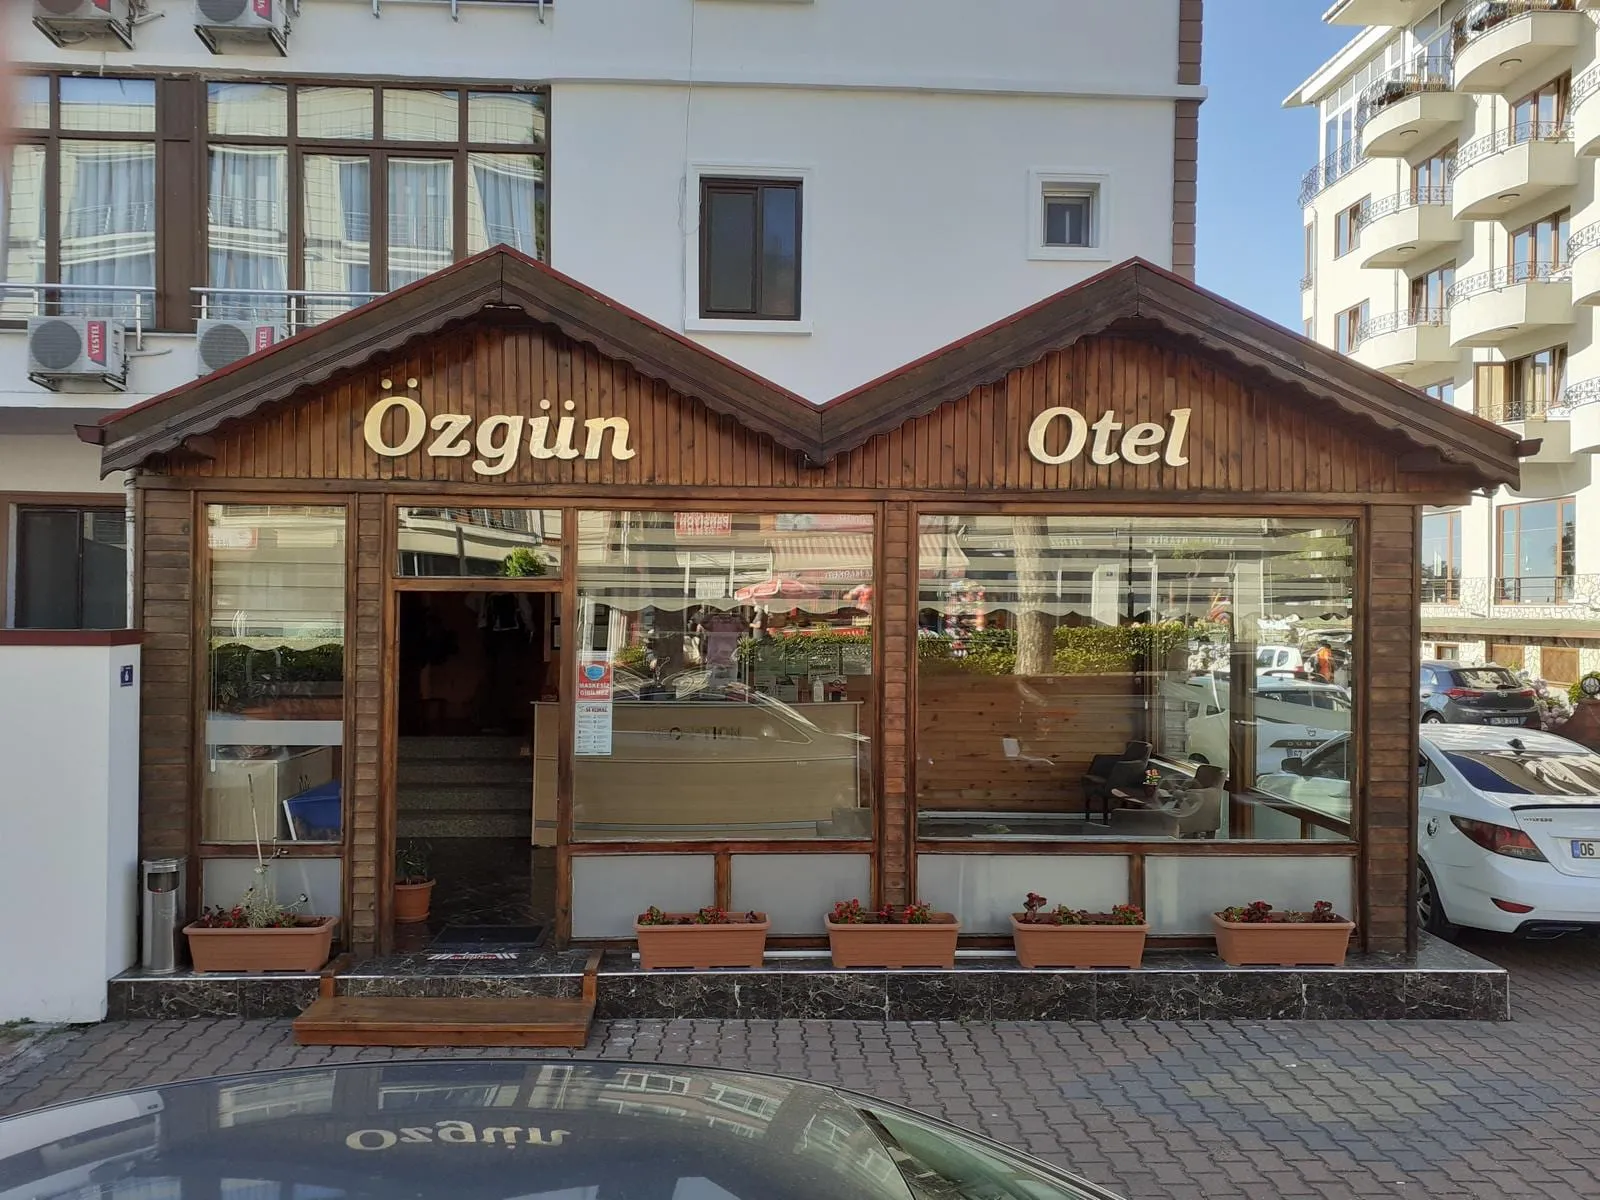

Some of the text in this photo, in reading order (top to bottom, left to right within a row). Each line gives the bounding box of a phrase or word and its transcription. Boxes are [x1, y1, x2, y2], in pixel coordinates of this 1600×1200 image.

[91, 325, 100, 354] VESTEL
[259, 331, 267, 351] STEL
[364, 377, 1192, 476] Özgün Otel
[1580, 843, 1595, 857] 06
